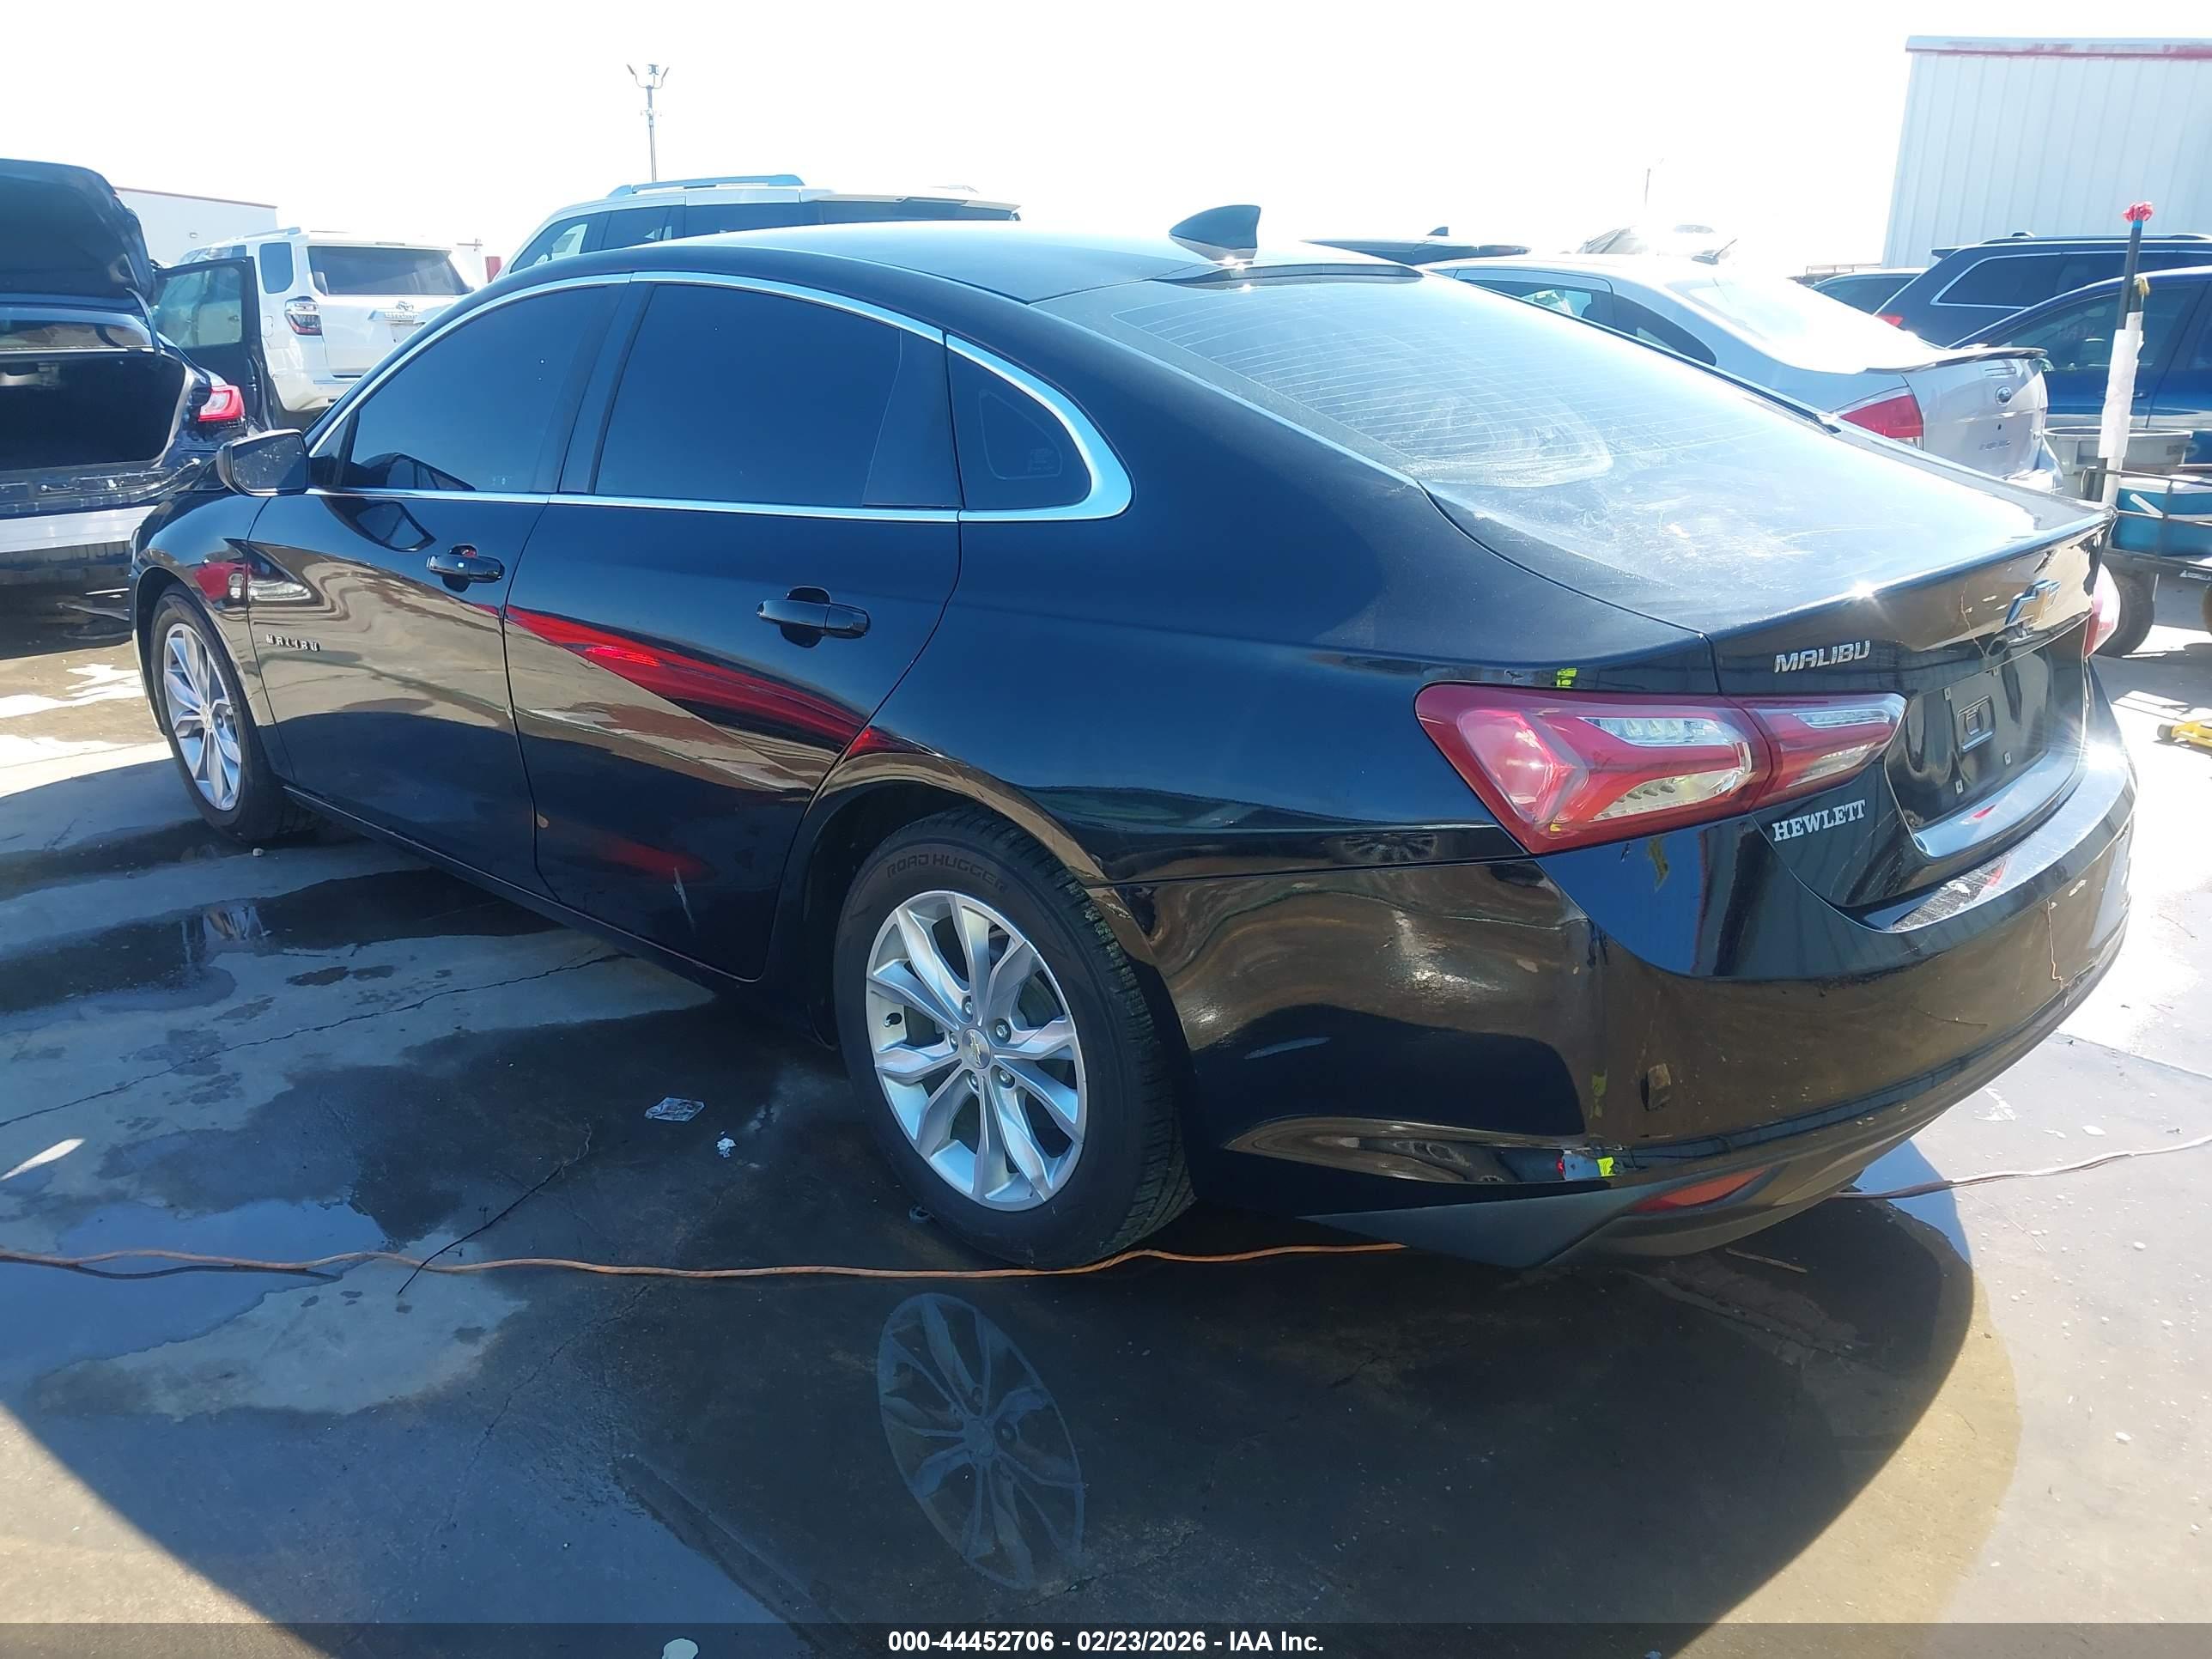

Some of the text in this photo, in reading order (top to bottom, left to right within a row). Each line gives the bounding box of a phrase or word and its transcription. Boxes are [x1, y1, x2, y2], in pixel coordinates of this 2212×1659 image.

[265, 633, 320, 652] MALIBU
[1774, 640, 1870, 673] MALIBU
[1771, 799, 1865, 842] HEWLETT
[886, 854, 1009, 892] ROAD HUGGER
